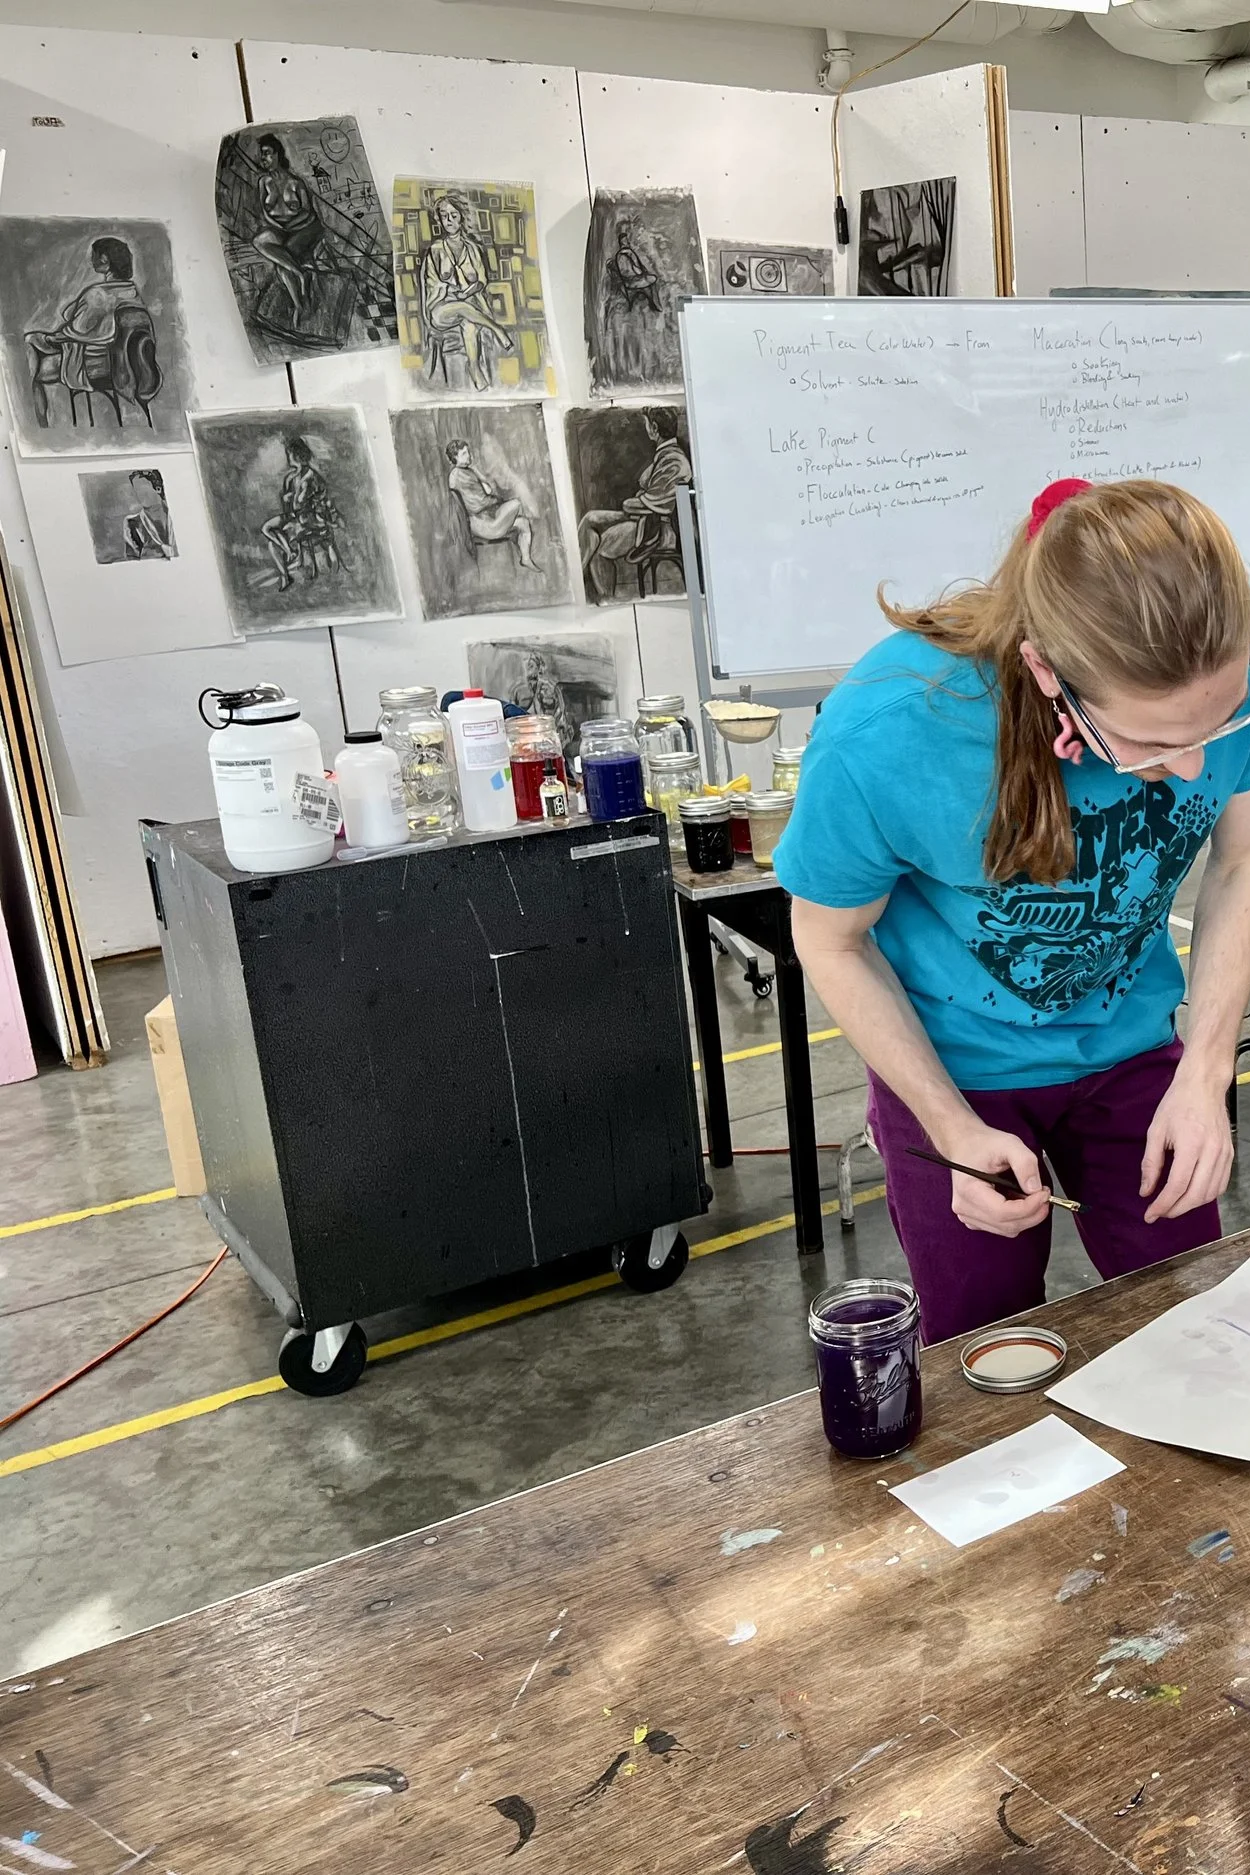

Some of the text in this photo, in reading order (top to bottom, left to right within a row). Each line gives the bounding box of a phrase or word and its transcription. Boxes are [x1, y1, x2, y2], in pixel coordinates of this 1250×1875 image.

[753, 329, 821, 370] Pigment
[826, 330, 857, 350] Tea
[966, 330, 991, 351] From
[1033, 326, 1091, 350] Maceration
[1082, 356, 1121, 375] Soaking
[800, 369, 845, 391] Solvent
[857, 375, 888, 387] Solute
[1145, 395, 1160, 406] and
[768, 427, 808, 453] Lake
[818, 427, 859, 459] Pigment
